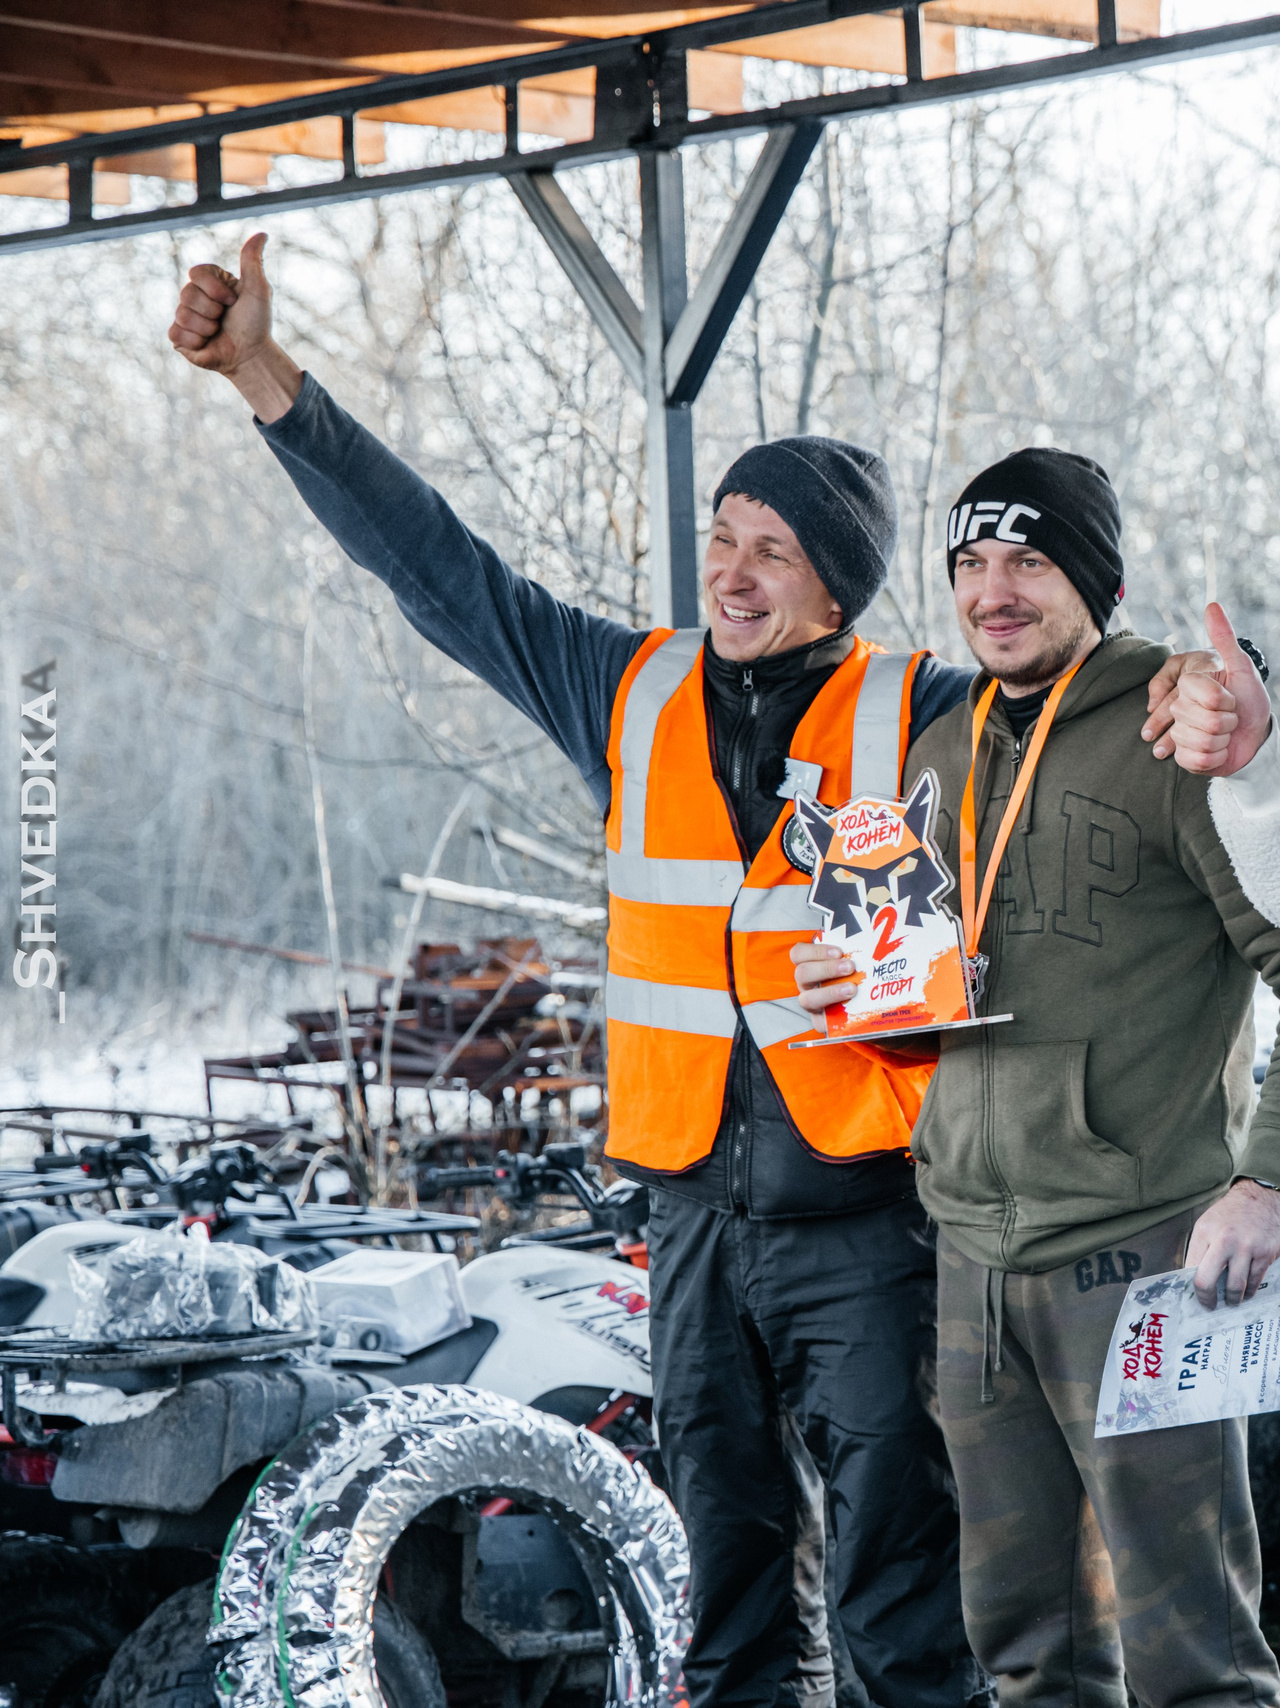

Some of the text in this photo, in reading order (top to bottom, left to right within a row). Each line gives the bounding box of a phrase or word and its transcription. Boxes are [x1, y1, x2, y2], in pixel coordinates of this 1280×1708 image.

[949, 502, 1041, 551] UFC
[839, 808, 869, 832] ХОД
[846, 821, 901, 852] КОНЁМ
[872, 906, 909, 961] 2
[872, 957, 907, 978] МЕСТО
[870, 976, 915, 1001] СПОРТ
[1075, 1250, 1142, 1294] GAP
[1140, 1313, 1170, 1379] КОНЁМ
[1240, 1323, 1254, 1374] ЗАНЯВШИЙ
[1267, 1334, 1272, 1342] по
[1122, 1343, 1144, 1381] ХОД
